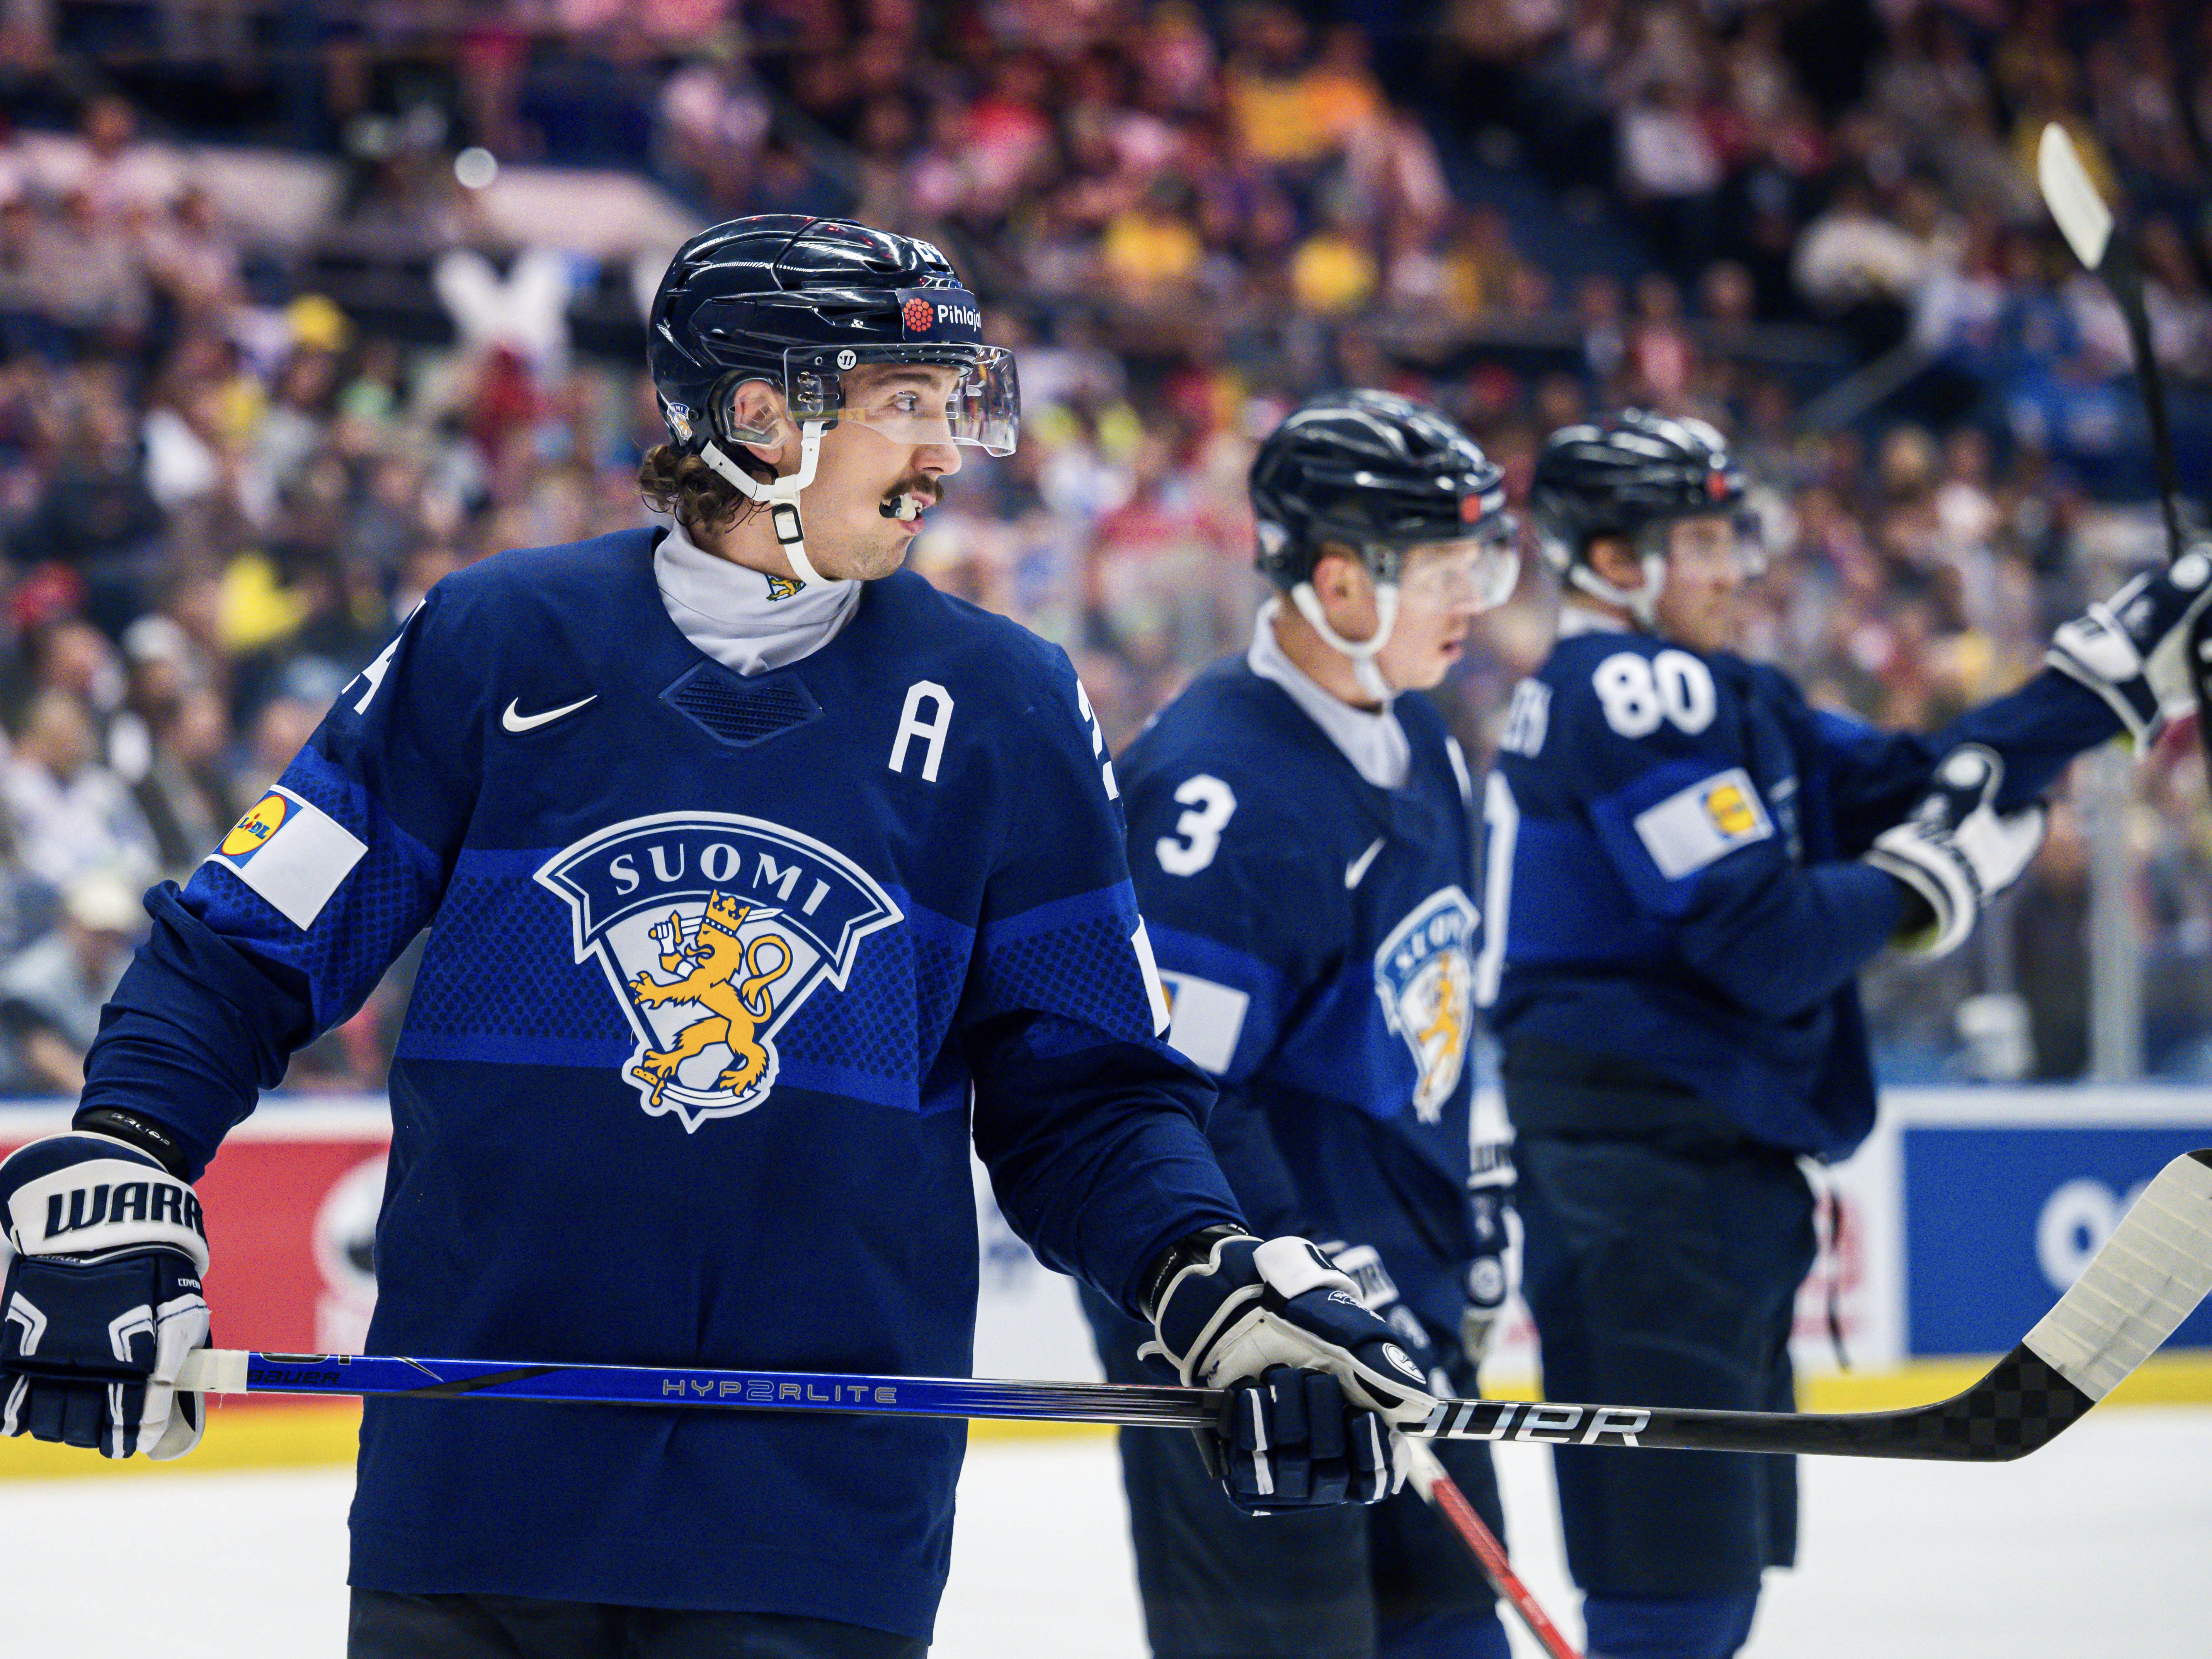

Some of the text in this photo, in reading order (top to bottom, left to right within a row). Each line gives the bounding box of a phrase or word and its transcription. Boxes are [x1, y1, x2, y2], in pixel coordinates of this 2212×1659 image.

[888, 680, 954, 783] A
[1591, 648, 1716, 738] 80
[1155, 774, 1236, 876] 3
[609, 843, 830, 916] SUOMI
[663, 1379, 897, 1404] HYP2RLITE
[1396, 1400, 1651, 1447] AUER
